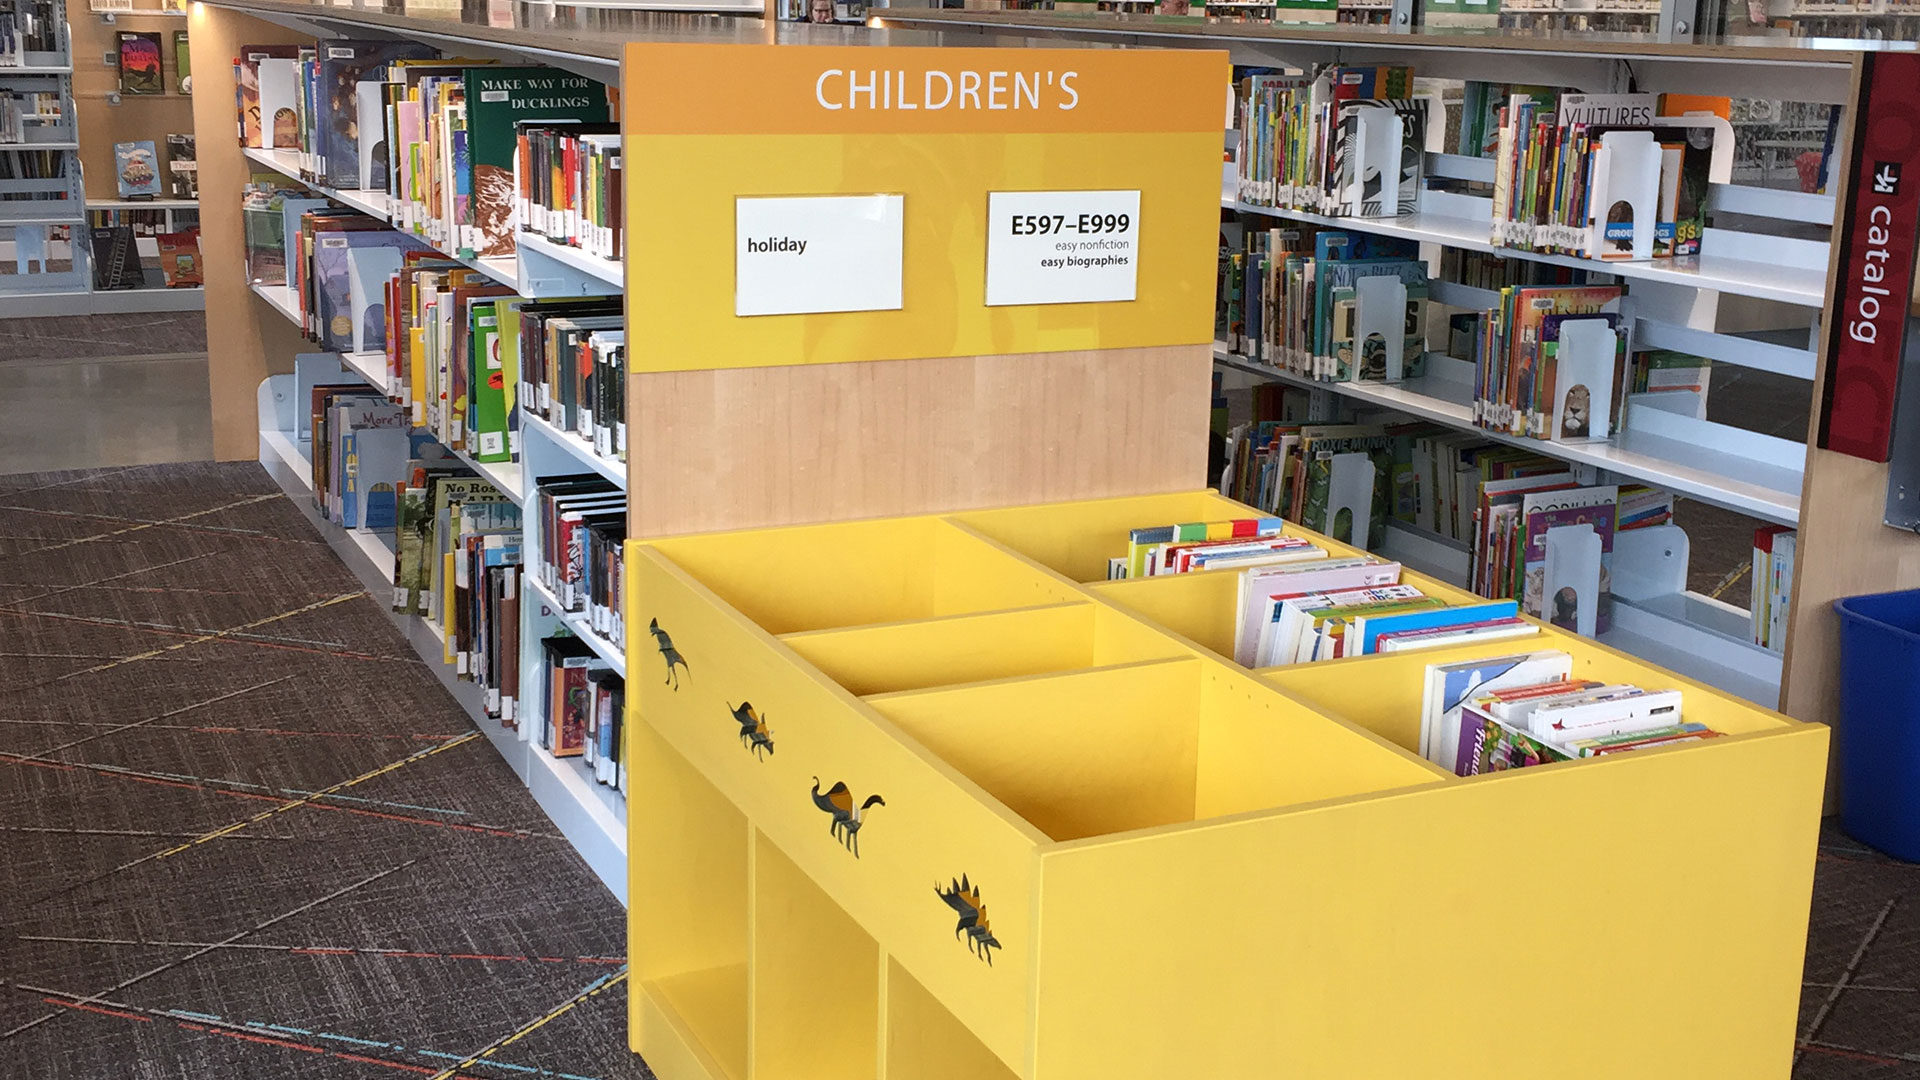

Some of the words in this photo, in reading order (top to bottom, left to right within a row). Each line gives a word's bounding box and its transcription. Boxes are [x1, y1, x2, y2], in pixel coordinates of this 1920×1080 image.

[481, 80, 522, 91] MAKE
[527, 79, 555, 90] WAY
[561, 78, 589, 89] FOR
[815, 69, 1079, 110] CHILDREN'S
[511, 96, 590, 109] DUCKLINGS
[747, 236, 808, 256] holiday
[1055, 242, 1078, 253] easy
[1079, 239, 1130, 250] nonfiction
[1040, 258, 1065, 269] easy
[1066, 255, 1129, 269] biographies
[1849, 205, 1892, 345] catalog
[362, 411, 393, 428] More
[1311, 439, 1349, 452] ROXIE
[445, 483, 466, 494] No
[469, 483, 502, 494] Ros
